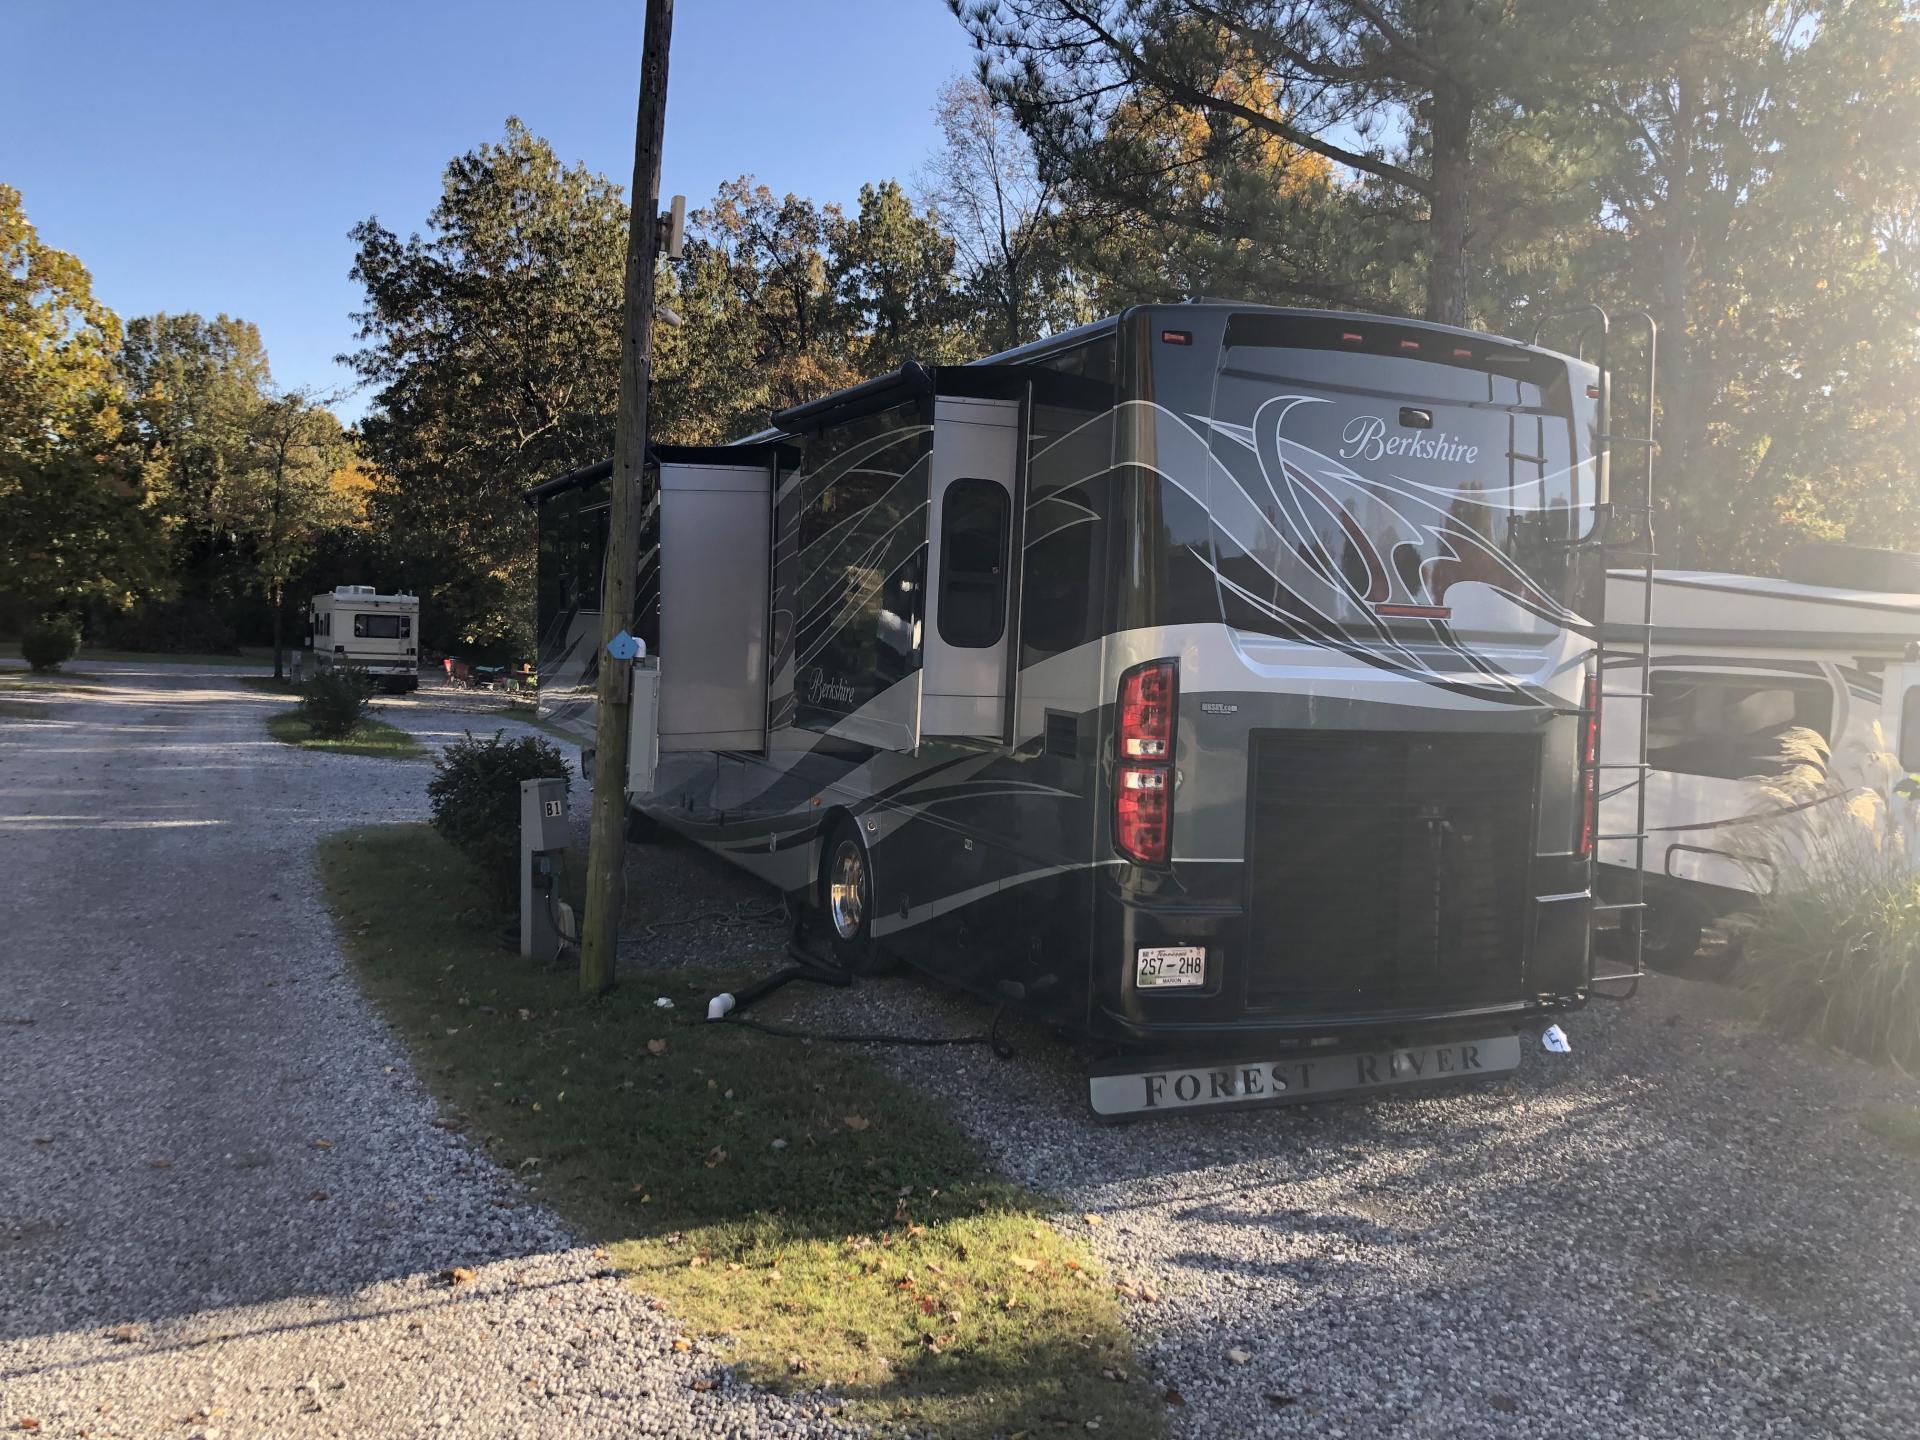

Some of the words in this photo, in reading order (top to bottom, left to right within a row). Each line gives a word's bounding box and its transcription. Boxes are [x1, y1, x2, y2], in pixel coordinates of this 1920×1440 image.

[1338, 415, 1478, 464] Berkshire
[807, 667, 855, 704] Berkshire
[546, 801, 561, 817] B1
[1142, 1063, 1315, 1108] FOREST
[1355, 1046, 1483, 1085] RIVER
